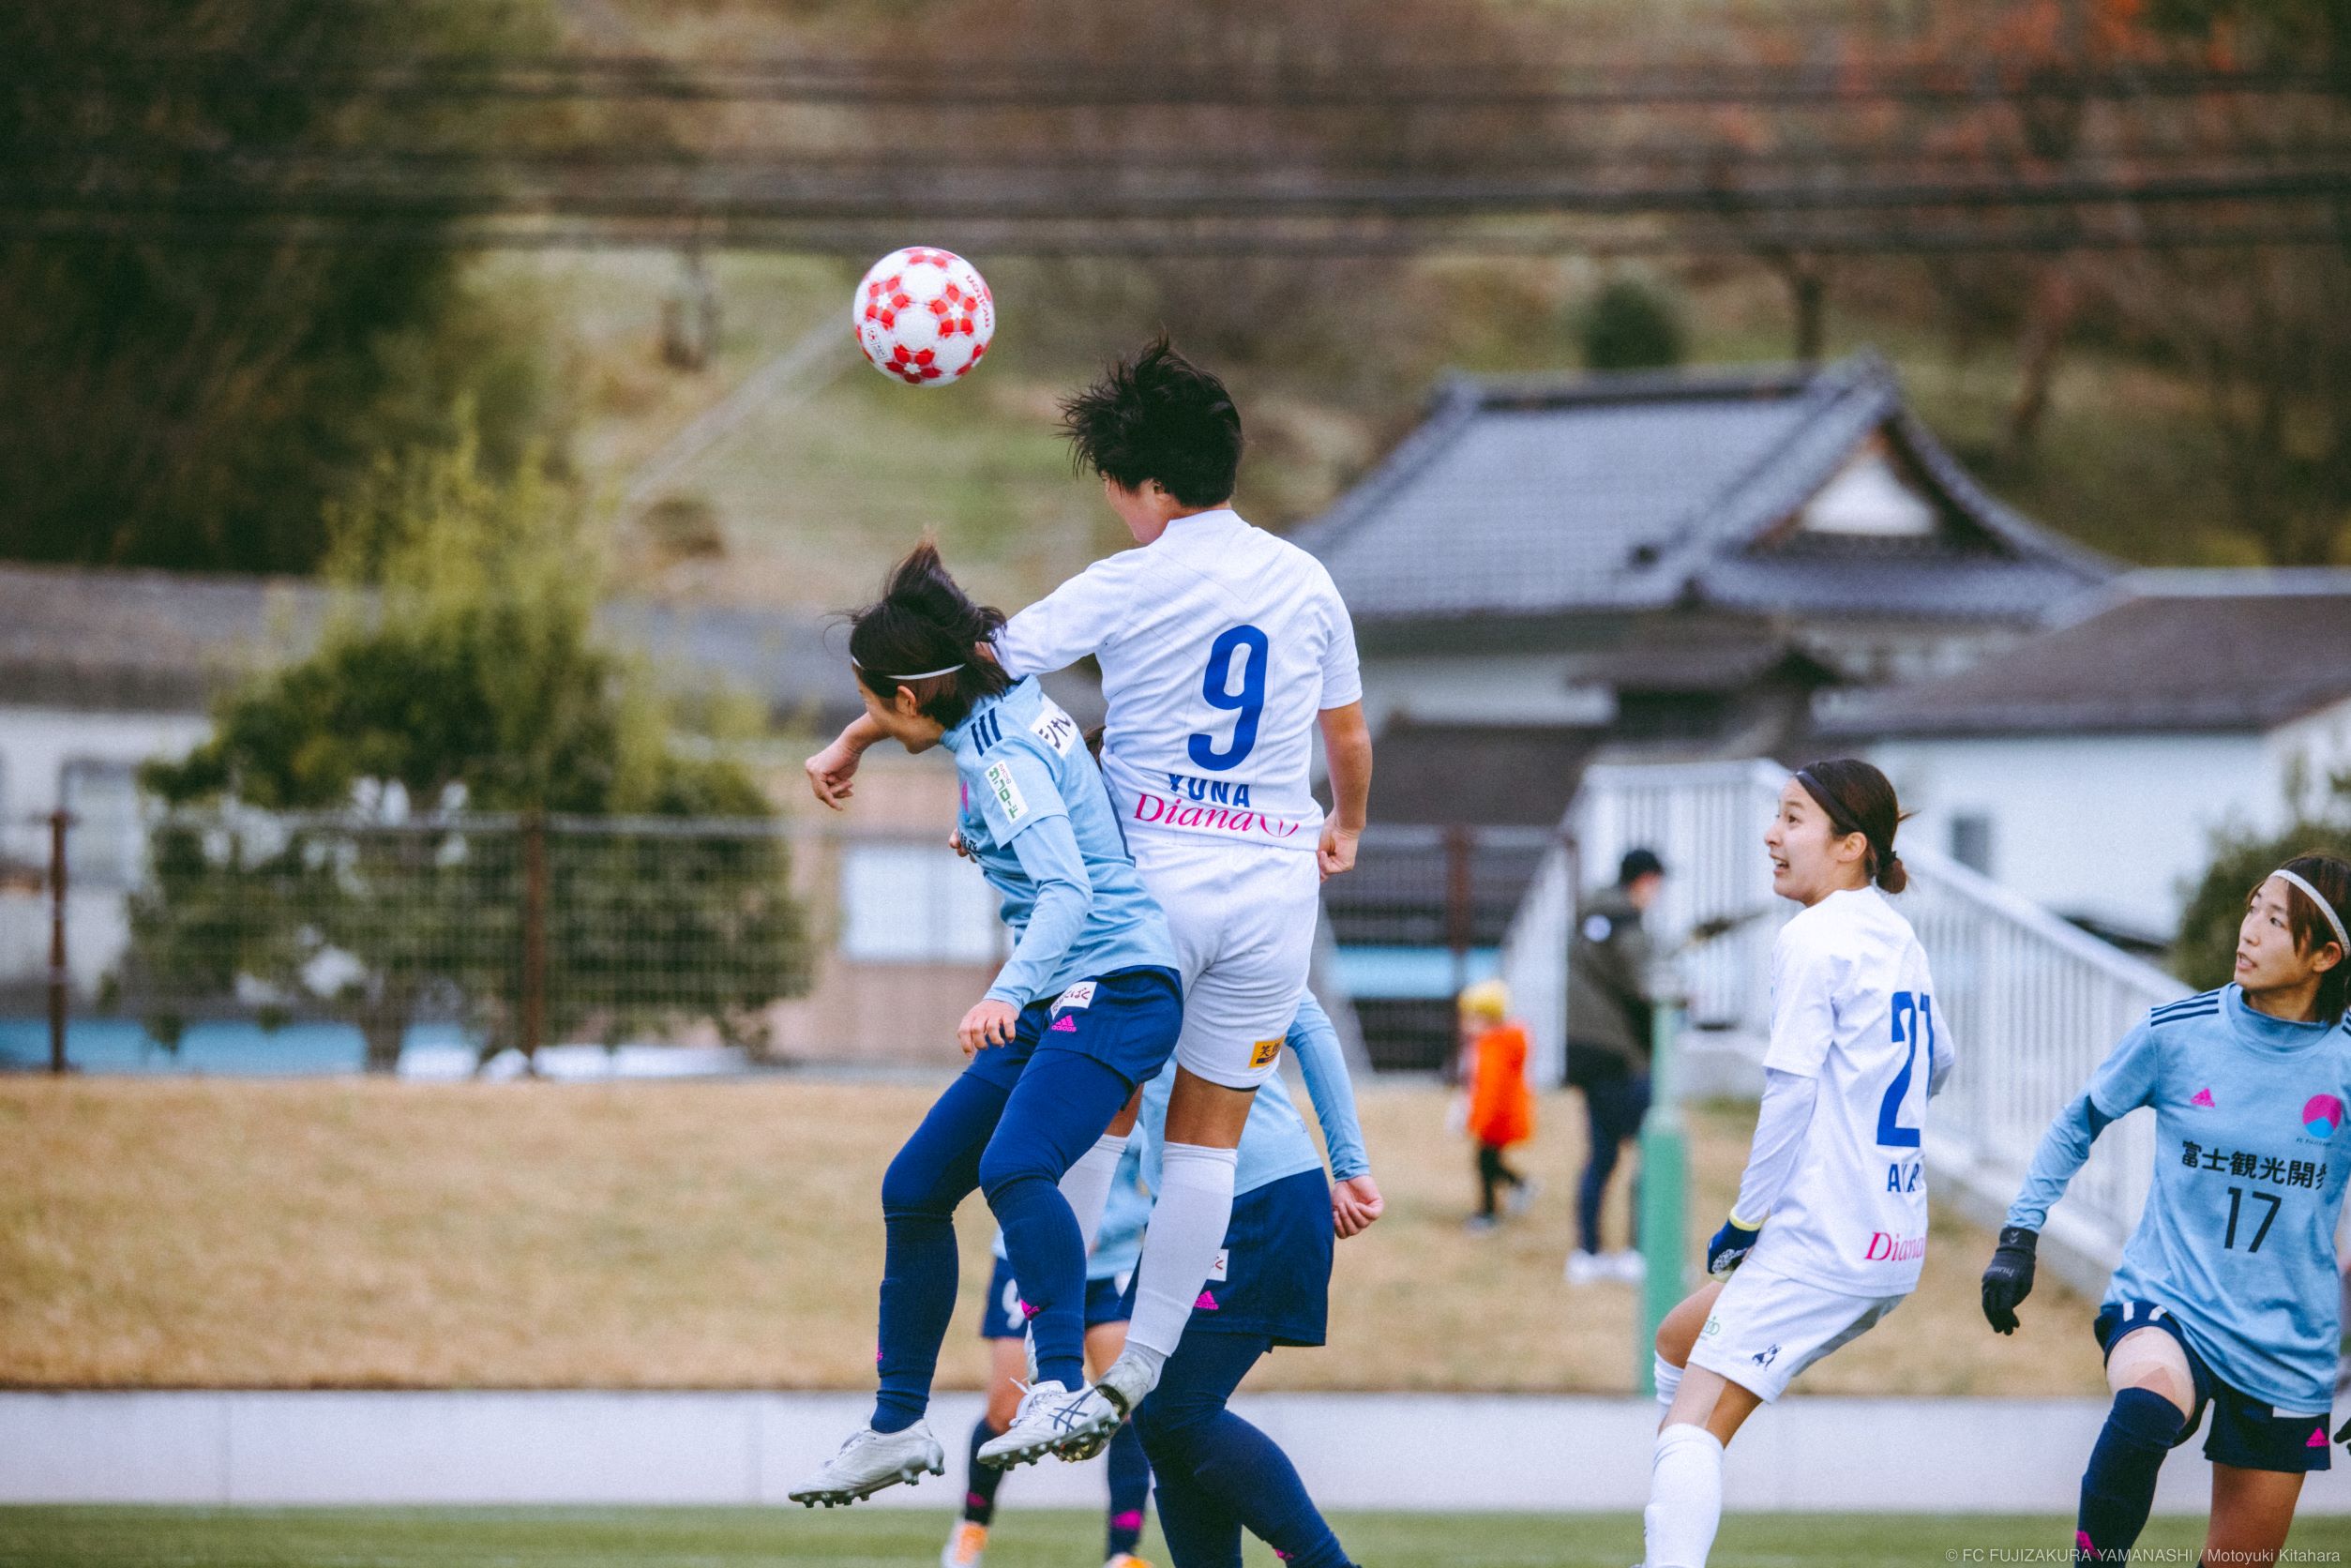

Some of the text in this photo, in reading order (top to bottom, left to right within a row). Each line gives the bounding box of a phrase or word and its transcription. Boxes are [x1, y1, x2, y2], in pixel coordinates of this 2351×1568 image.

[1187, 624, 1269, 772] 9
[988, 766, 1018, 820] サンロード
[1133, 792, 1255, 832] Diana
[1168, 772, 1250, 808] YUNA
[1876, 990, 1935, 1148] 21
[2223, 1186, 2283, 1253] 17
